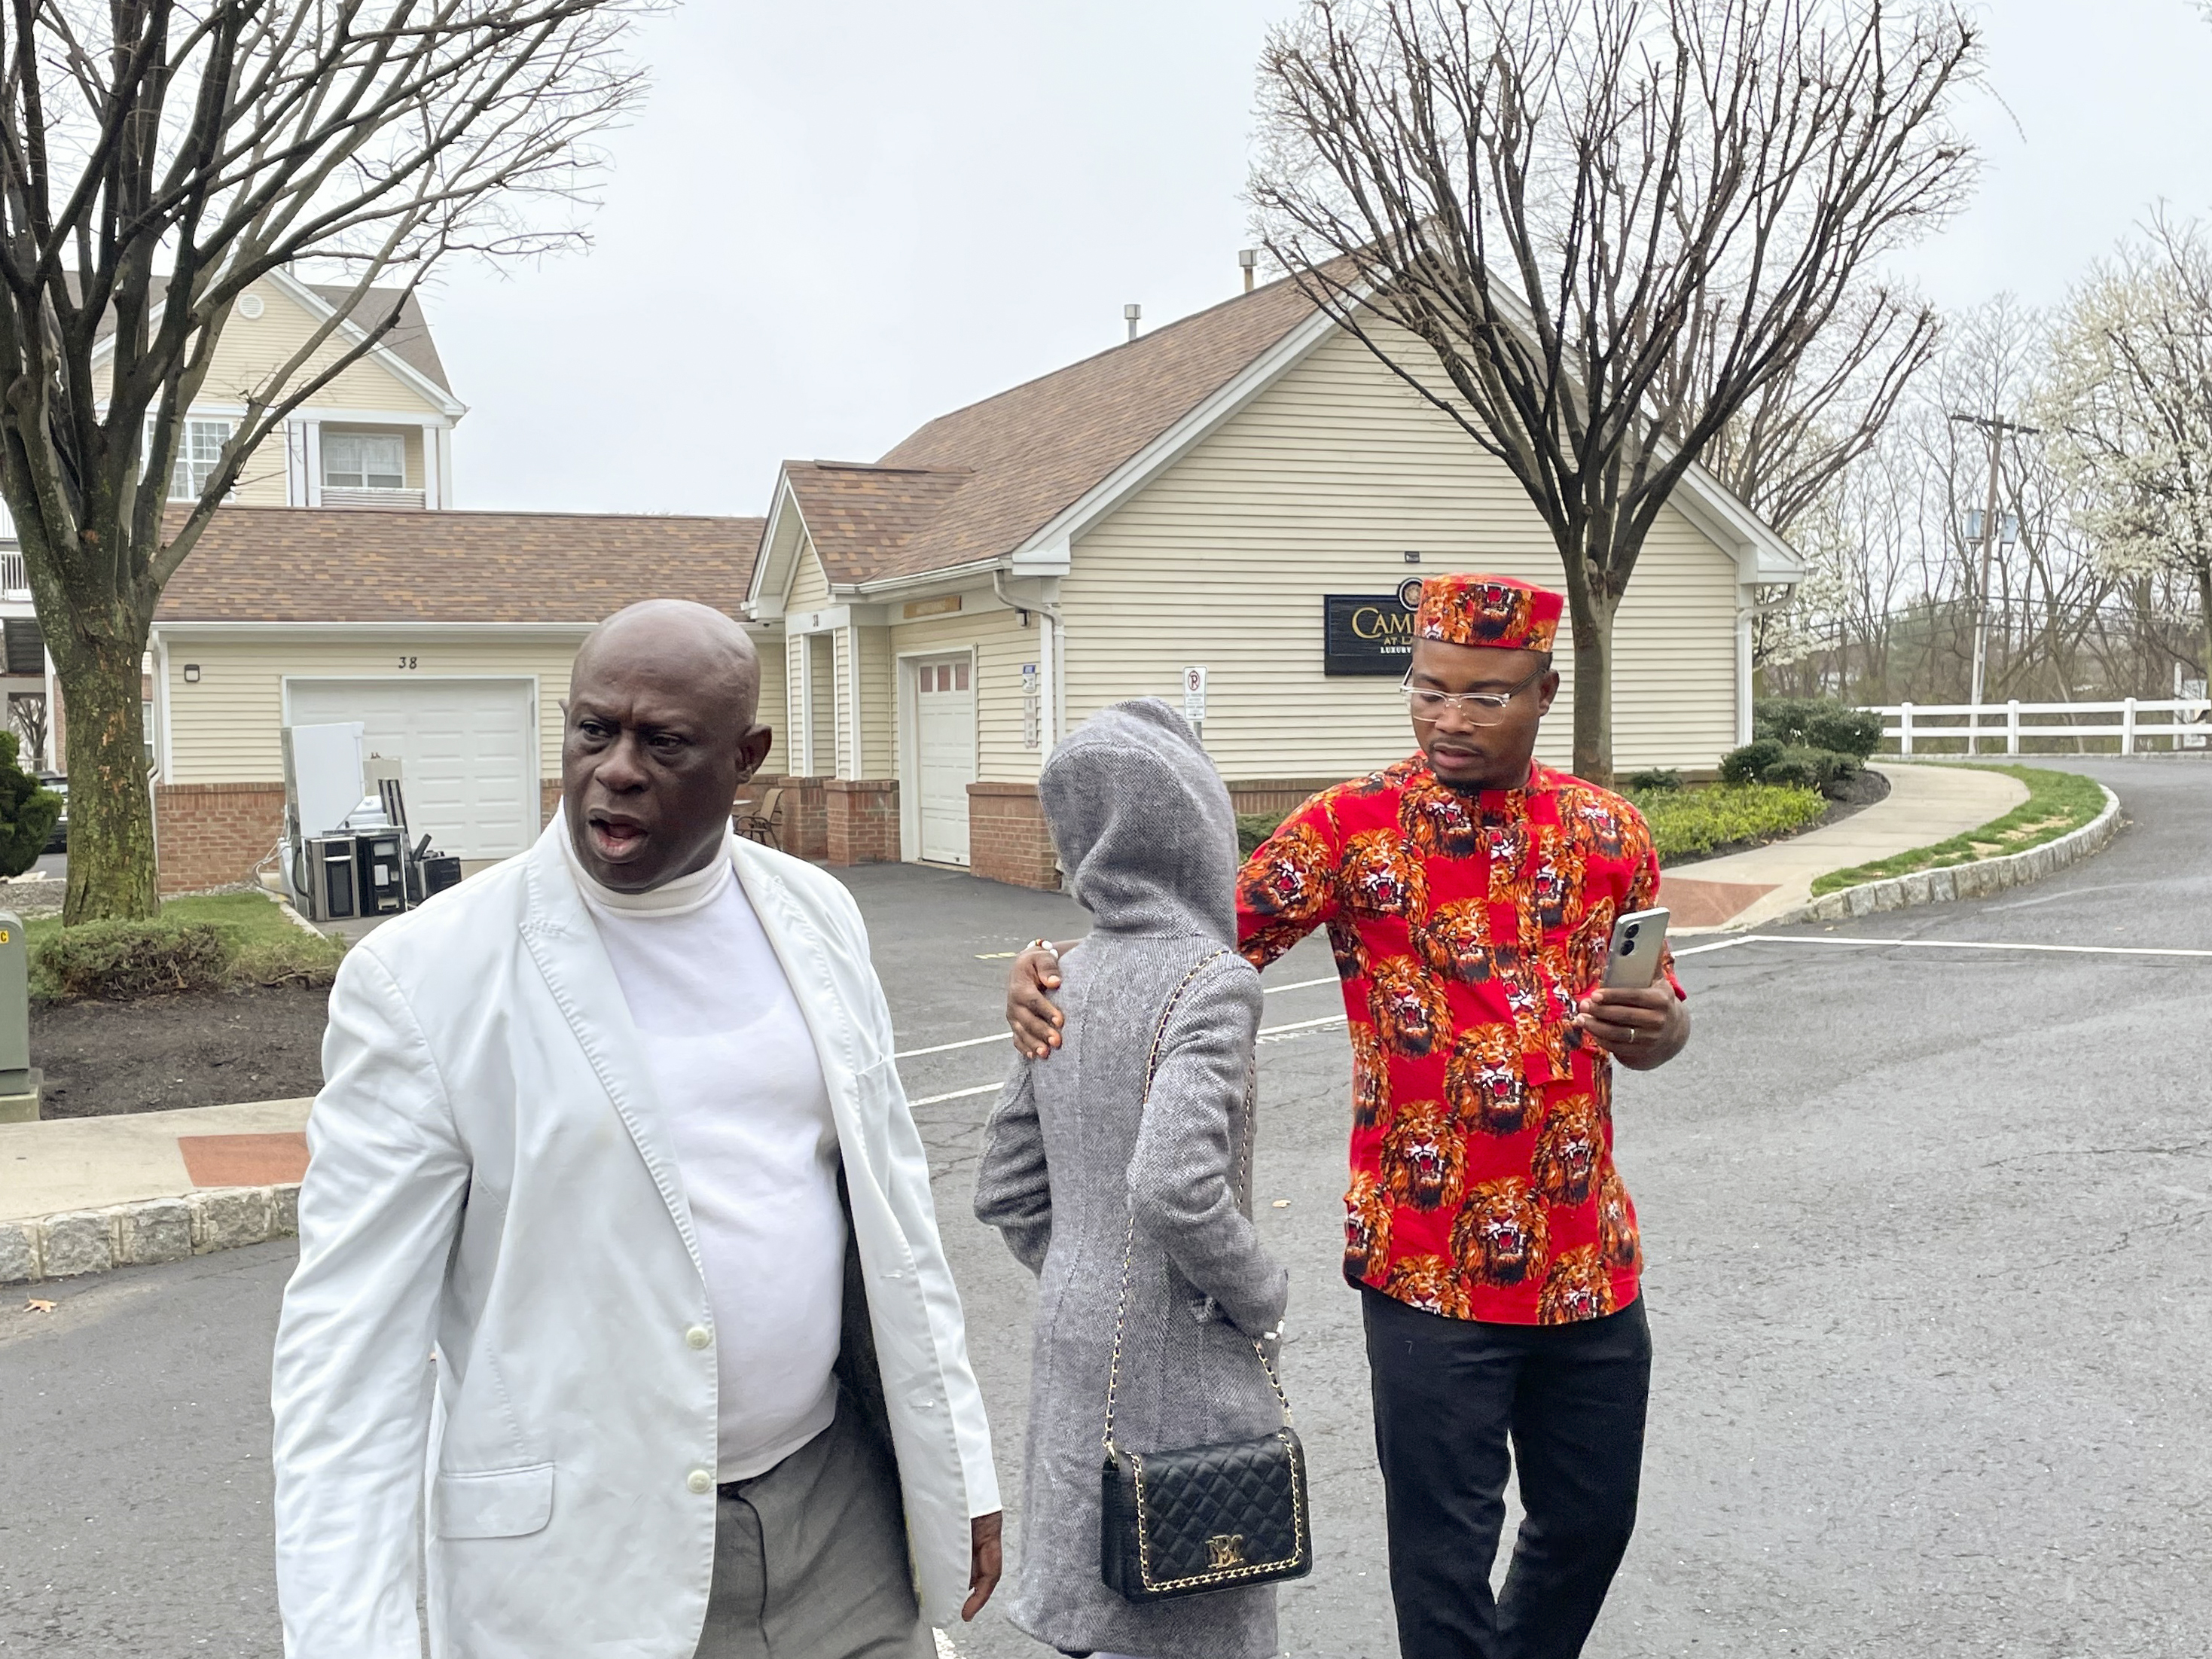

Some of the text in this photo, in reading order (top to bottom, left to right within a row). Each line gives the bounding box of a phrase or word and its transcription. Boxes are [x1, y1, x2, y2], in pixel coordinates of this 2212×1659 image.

[1352, 607, 1413, 639] CAM
[1384, 636, 1398, 645] AT
[398, 656, 417, 669] 38
